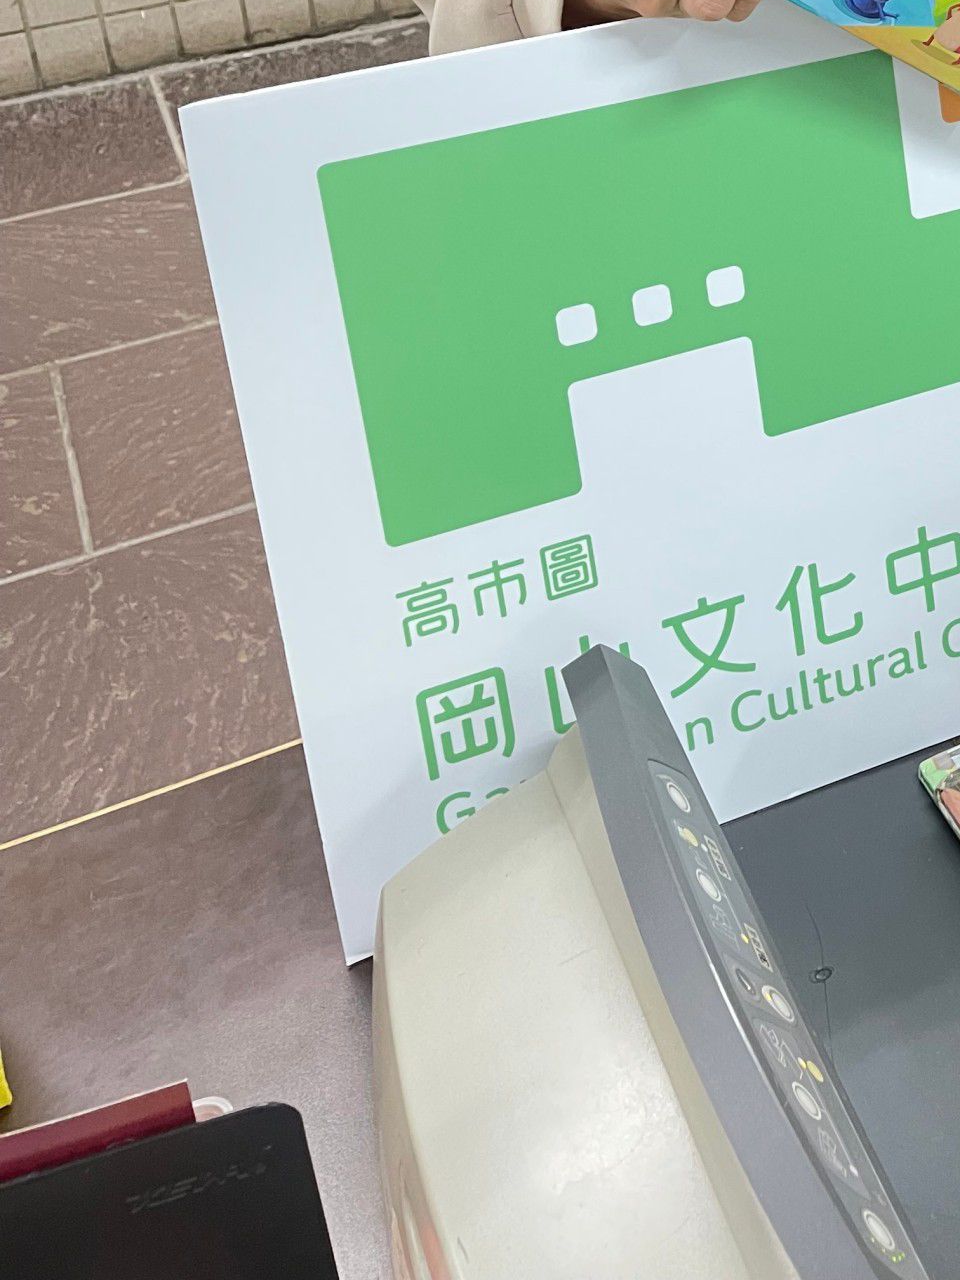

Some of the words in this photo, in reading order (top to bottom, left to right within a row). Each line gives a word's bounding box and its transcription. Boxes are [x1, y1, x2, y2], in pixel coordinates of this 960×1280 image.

[395, 534, 598, 647] 高市圖
[731, 631, 926, 732] Cultural
